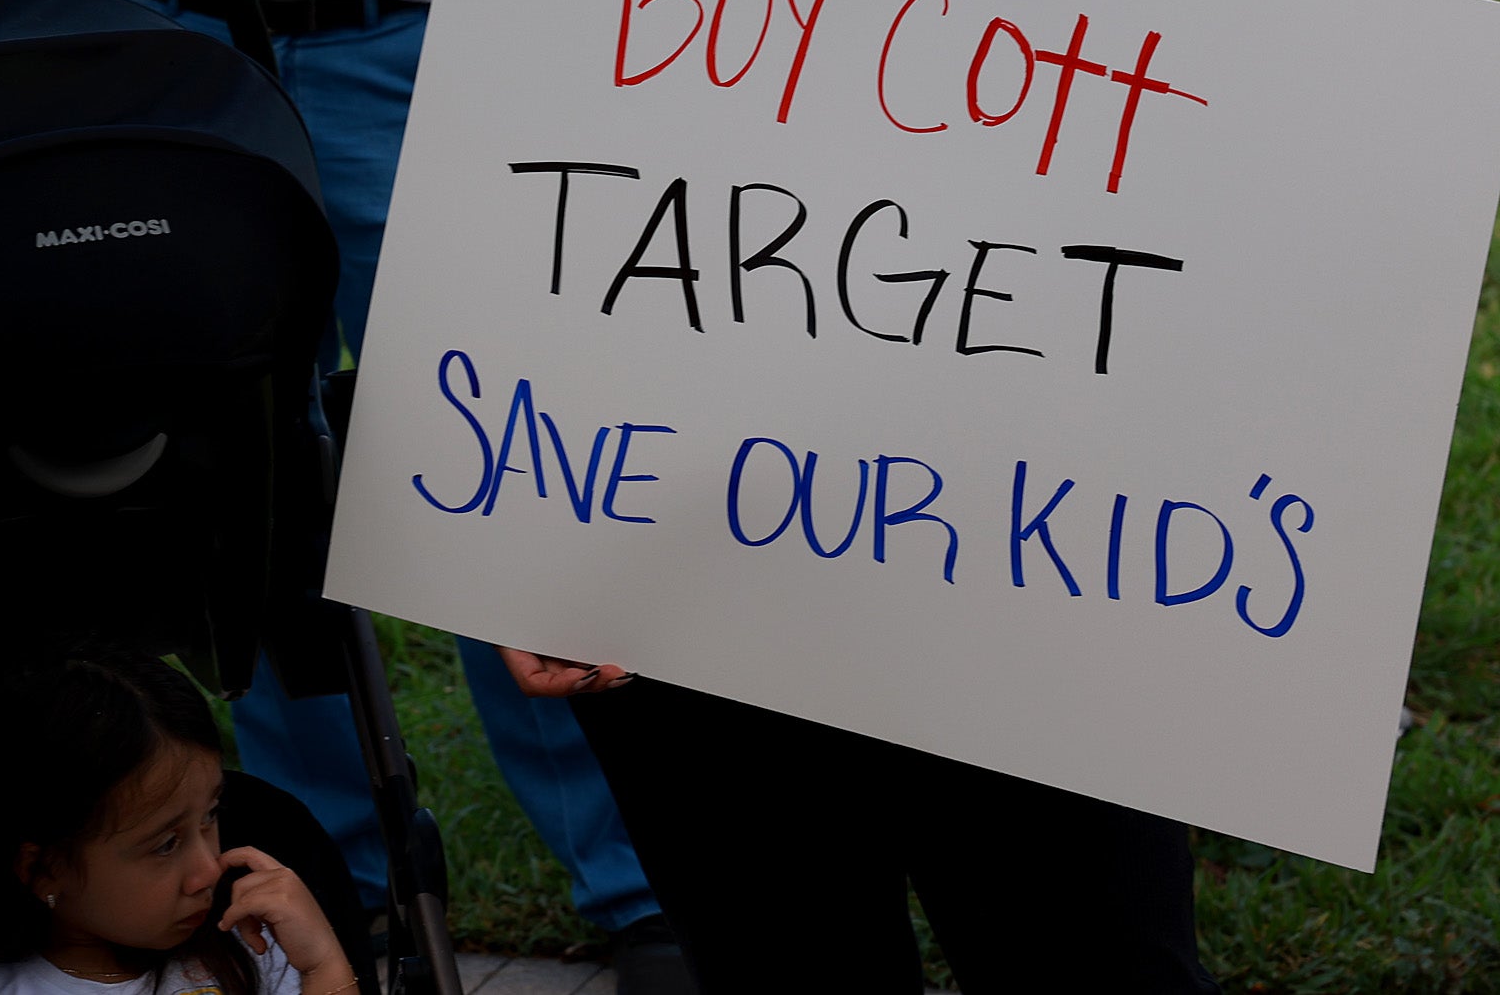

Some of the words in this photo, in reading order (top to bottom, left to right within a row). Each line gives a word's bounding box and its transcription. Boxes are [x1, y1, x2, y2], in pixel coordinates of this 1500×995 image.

[506, 160, 1185, 376] TARGET
[411, 348, 678, 525] SAVE
[726, 436, 959, 585] OUR
[1009, 459, 1315, 639] KID'S
